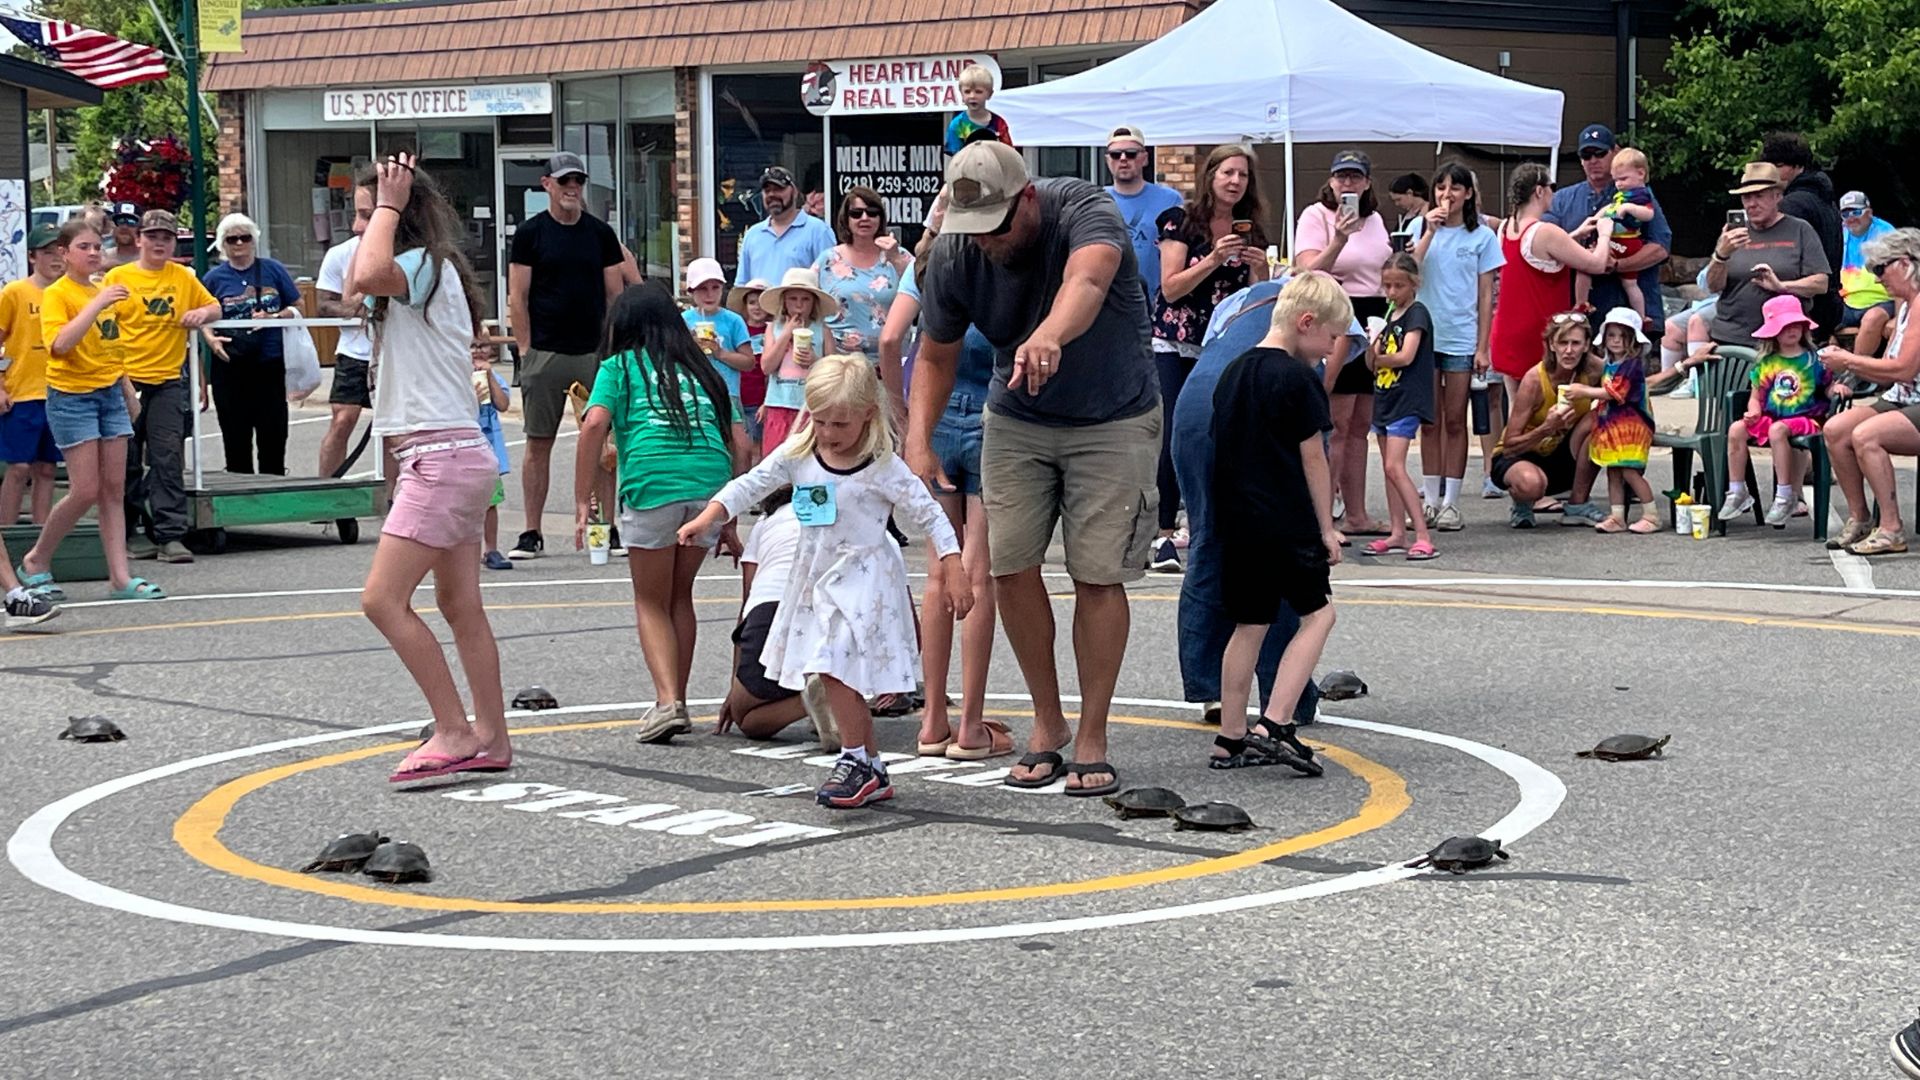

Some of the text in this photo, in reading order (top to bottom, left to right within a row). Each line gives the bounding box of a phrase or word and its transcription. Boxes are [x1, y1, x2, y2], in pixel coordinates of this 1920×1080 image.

[363, 91, 407, 115] POST
[411, 88, 467, 114] OFFICE
[843, 85, 960, 109] REAL ESTA
[836, 145, 942, 172] MELANIE MIX
[877, 175, 940, 194] 259-3082
[880, 196, 923, 224] OKER
[441, 783, 843, 847] START
